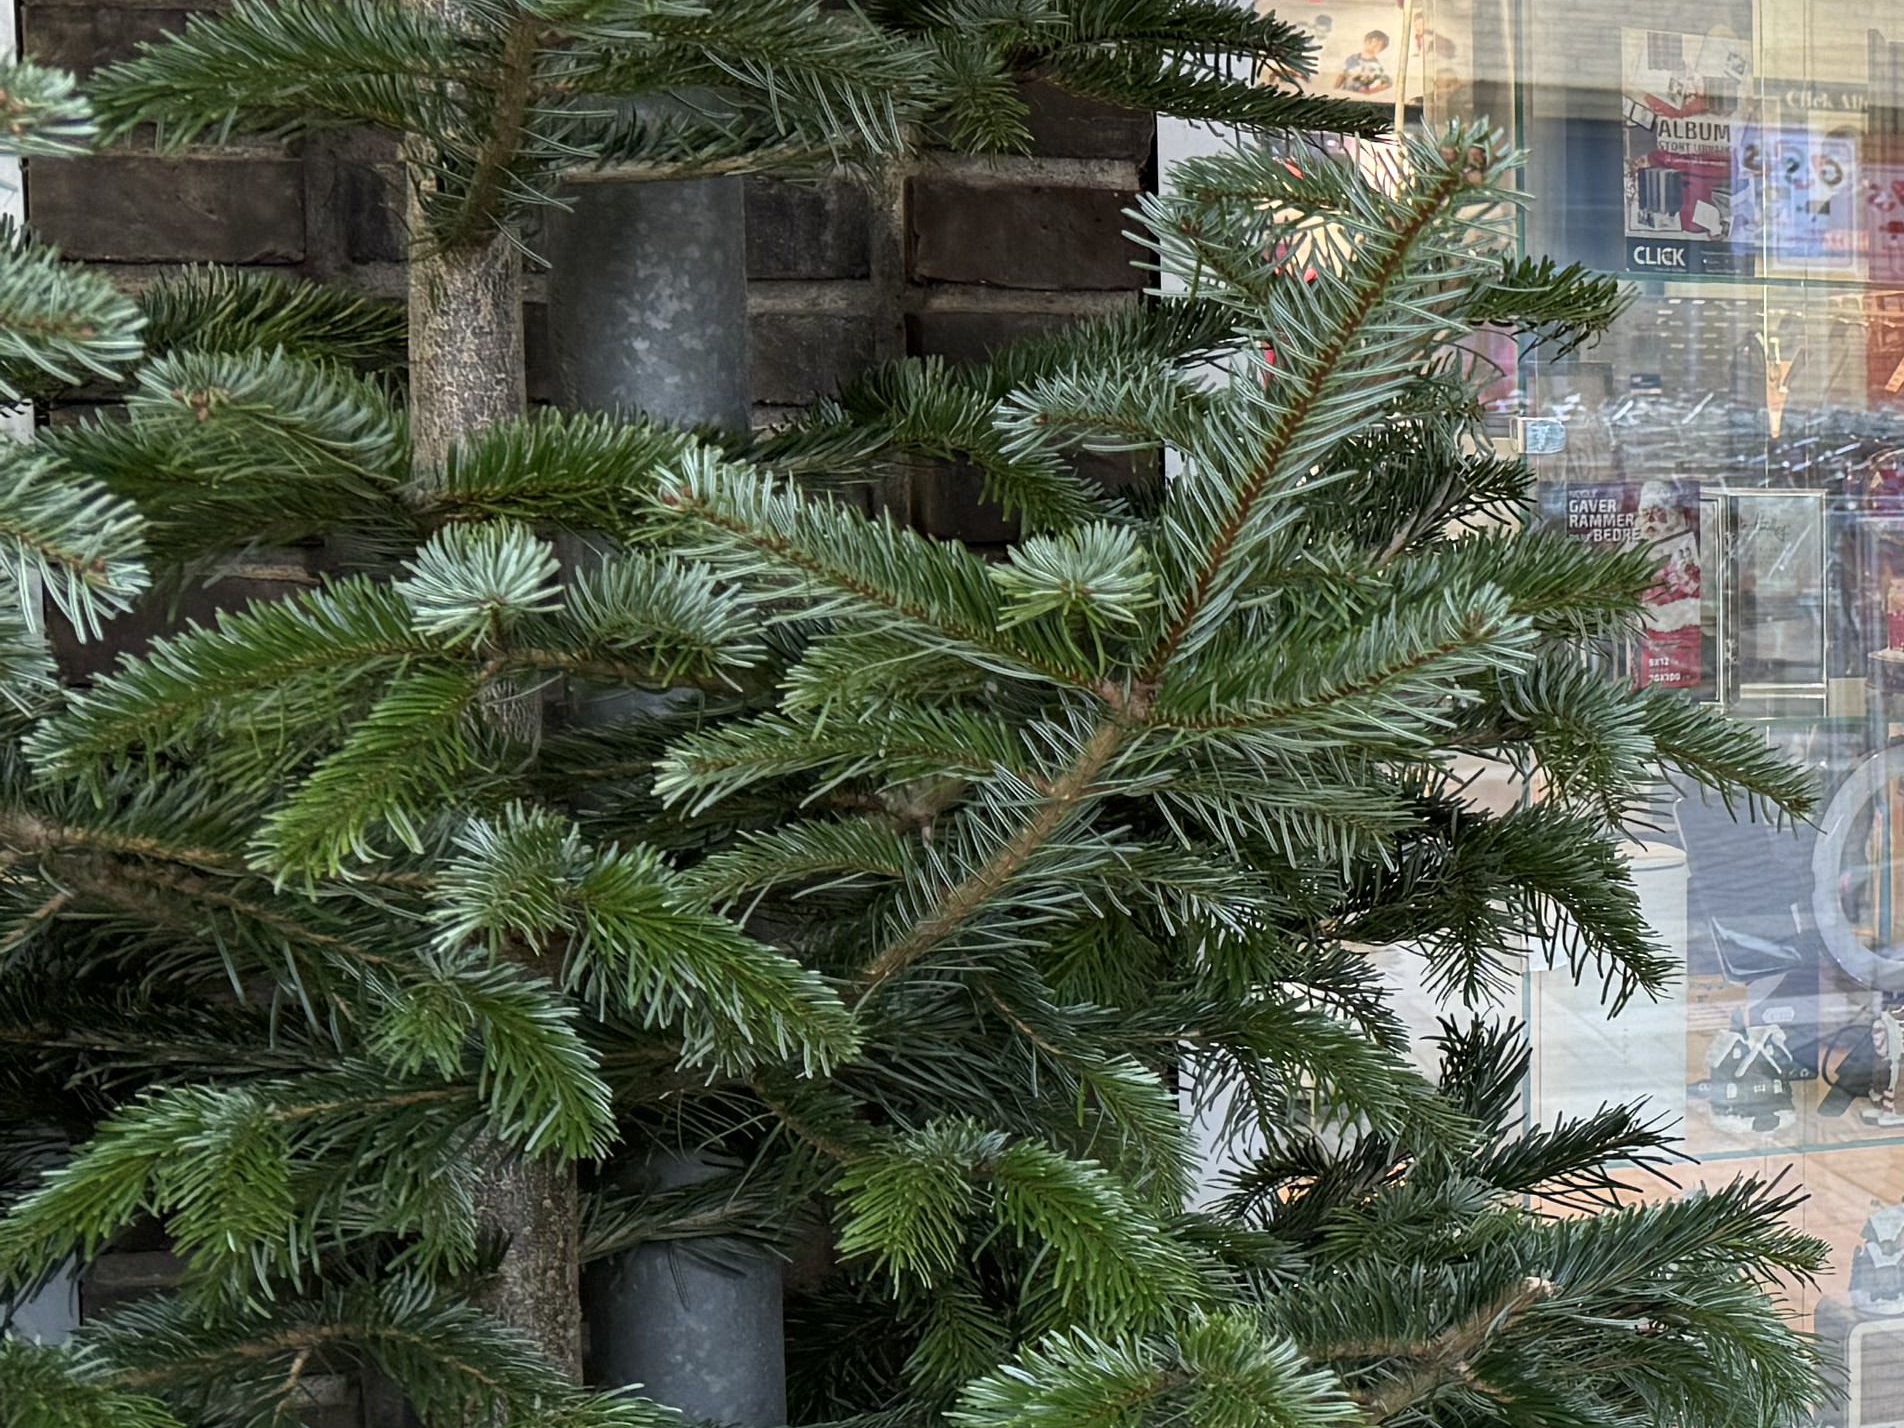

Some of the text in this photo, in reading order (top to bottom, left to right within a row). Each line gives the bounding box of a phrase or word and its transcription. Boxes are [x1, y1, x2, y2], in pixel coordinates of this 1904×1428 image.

[1658, 120, 1731, 143] ALBUM
[1633, 245, 1686, 267] CLICK
[1569, 498, 1617, 513] GAVER
[1569, 513, 1635, 528] RAMMER
[1593, 528, 1642, 543] BEDRE
